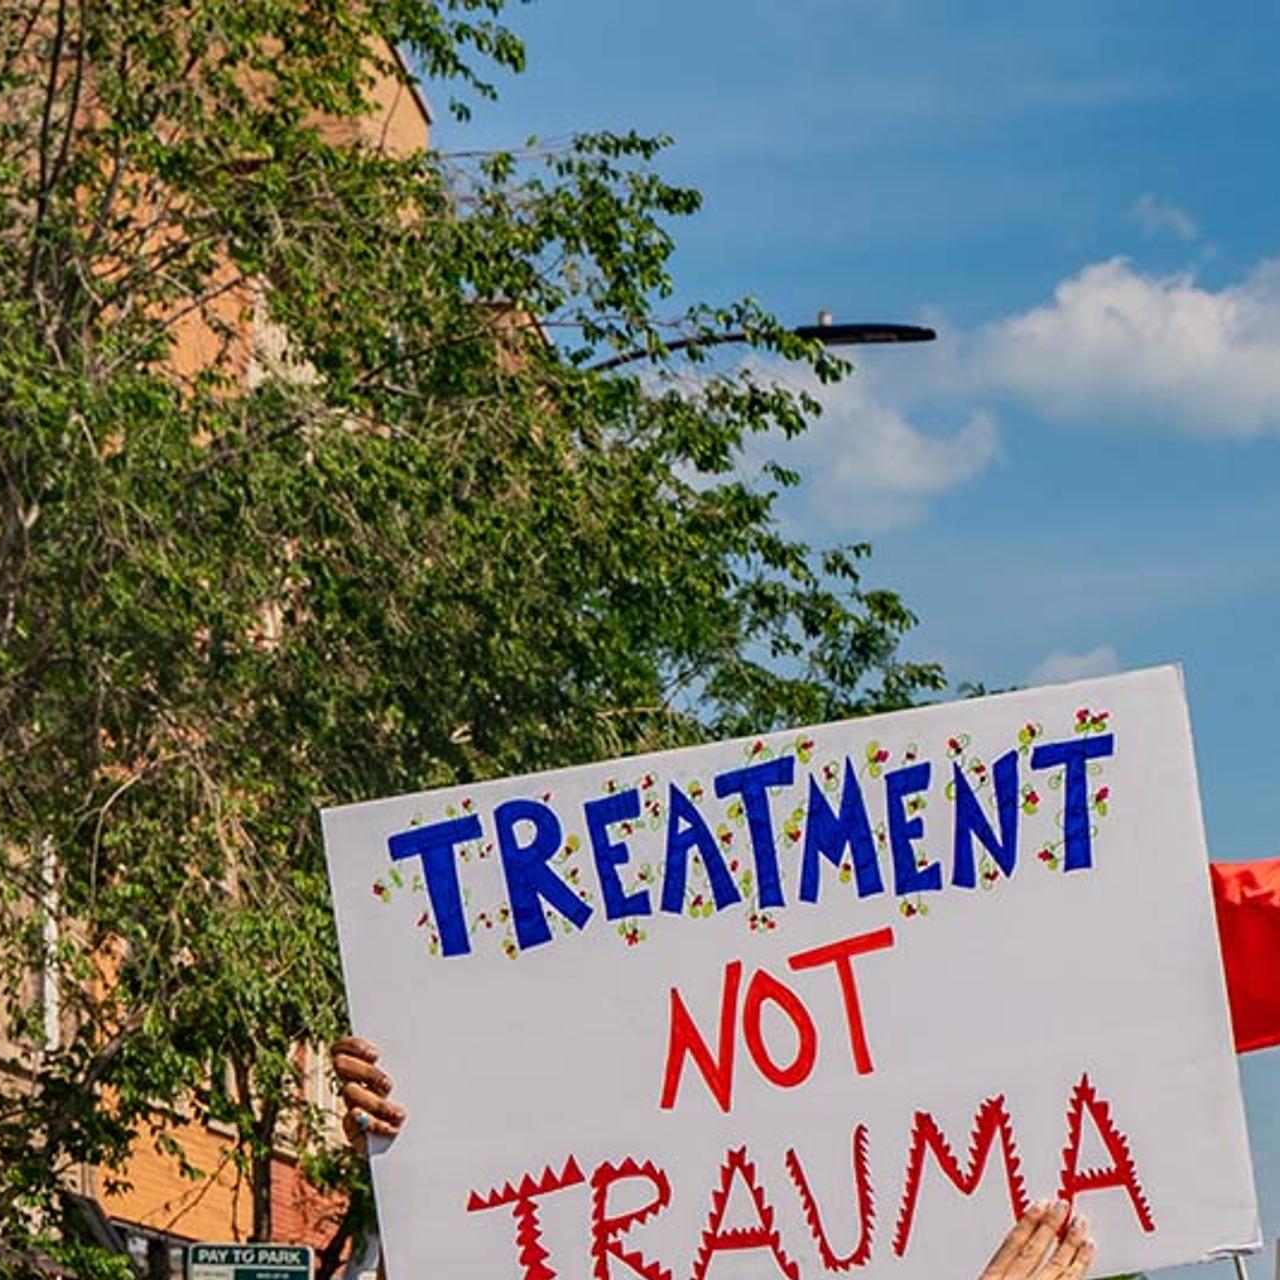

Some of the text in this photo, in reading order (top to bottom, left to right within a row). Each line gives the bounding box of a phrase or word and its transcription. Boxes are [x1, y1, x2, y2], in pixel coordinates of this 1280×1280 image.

[388, 733, 1115, 957] TREATMENT
[660, 927, 896, 1113] NOT
[197, 1248, 301, 1265] PAY TO PARK
